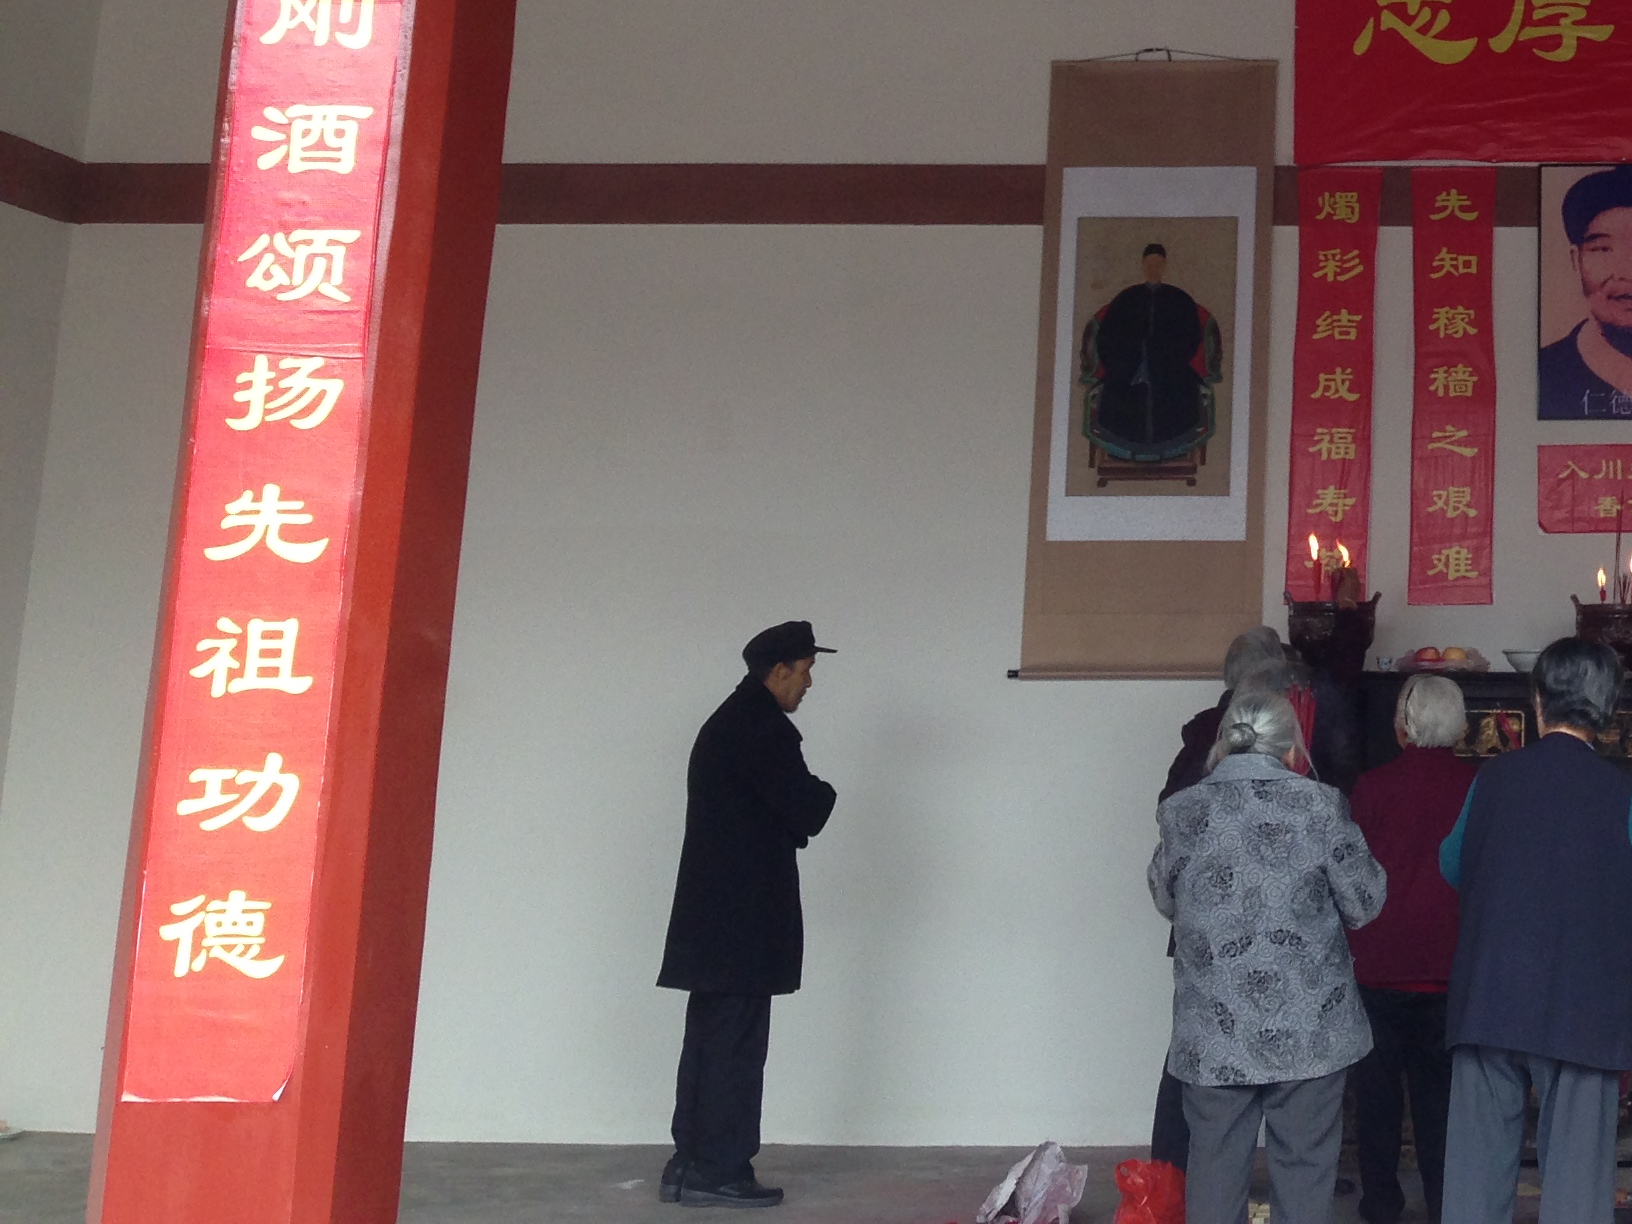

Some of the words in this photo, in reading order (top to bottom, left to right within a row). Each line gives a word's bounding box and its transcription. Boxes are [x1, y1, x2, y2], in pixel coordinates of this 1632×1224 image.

[1426, 188, 1479, 582] 先知稼穑之艰难
